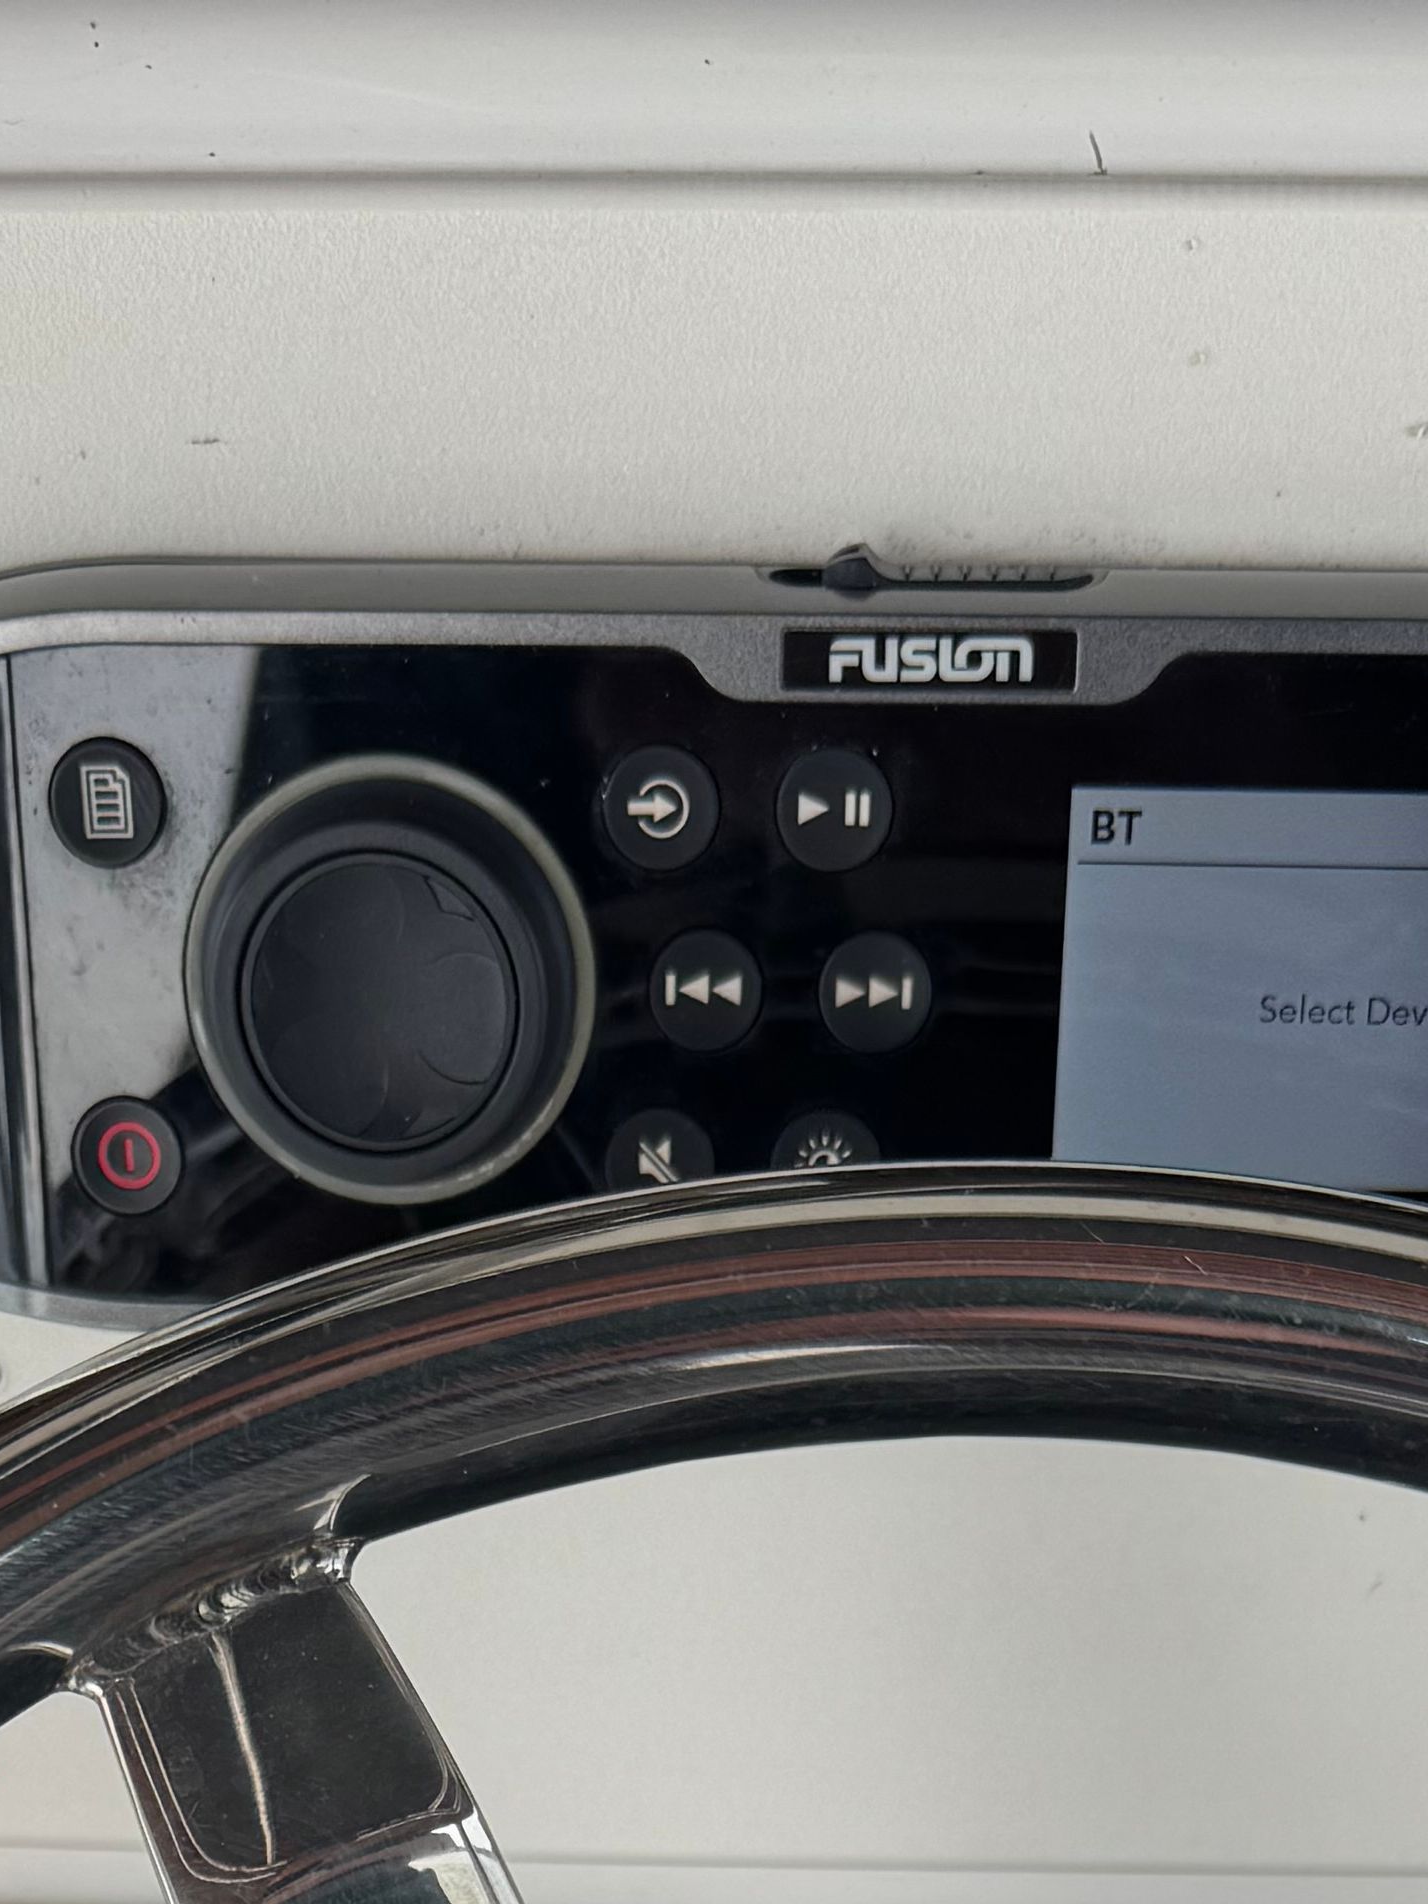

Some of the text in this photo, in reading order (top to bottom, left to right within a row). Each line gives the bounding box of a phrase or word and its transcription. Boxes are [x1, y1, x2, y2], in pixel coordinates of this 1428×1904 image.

[828, 635, 1034, 683] FUSION
[1090, 809, 1143, 846] BT
[1260, 995, 1356, 1026] Select
